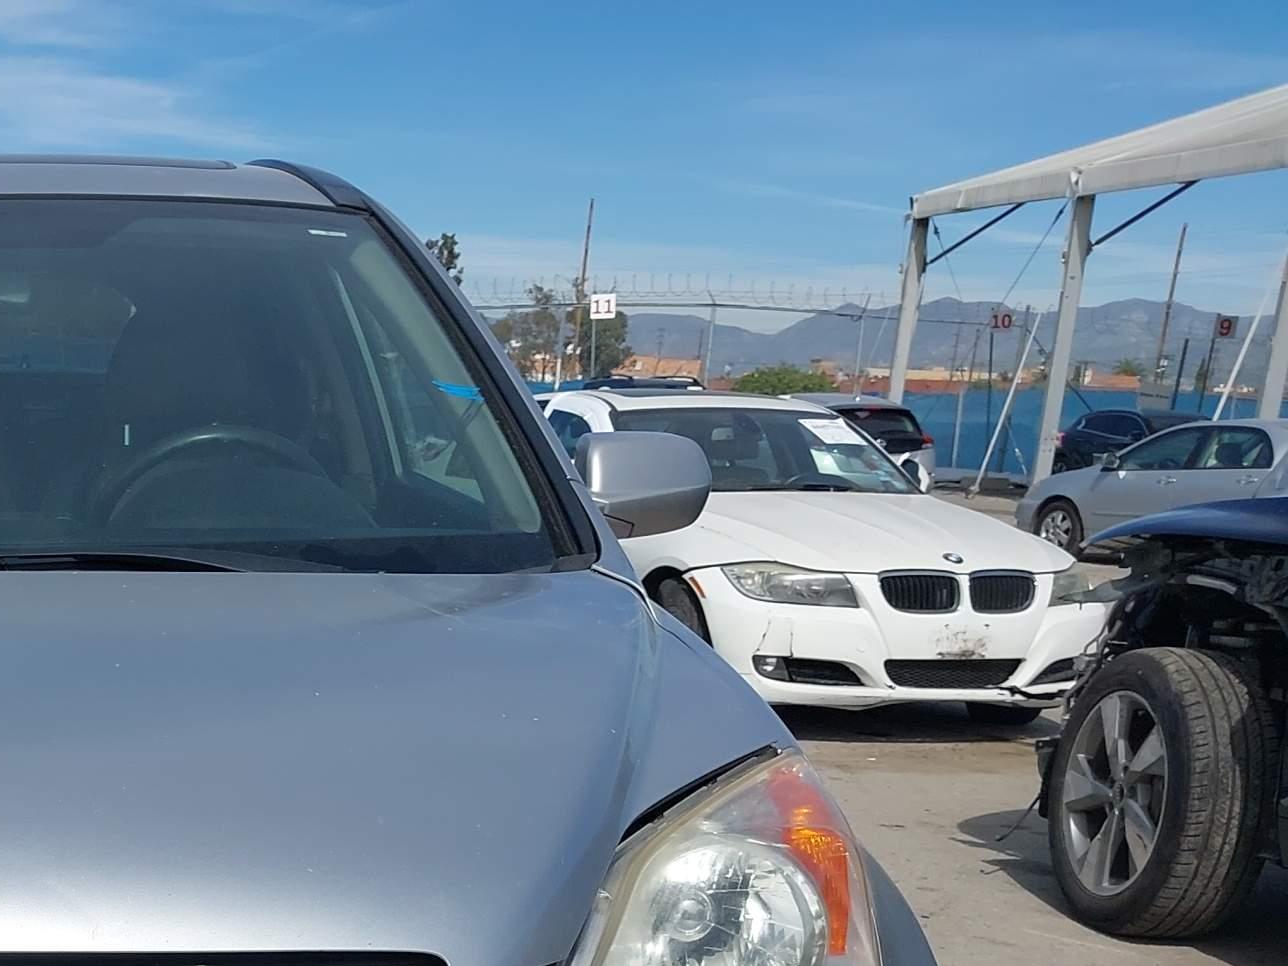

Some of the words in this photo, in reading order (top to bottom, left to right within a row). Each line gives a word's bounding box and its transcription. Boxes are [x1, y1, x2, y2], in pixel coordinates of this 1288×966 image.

[593, 299, 614, 314] 11
[991, 314, 1012, 329] 10
[1219, 319, 1232, 336] 9
